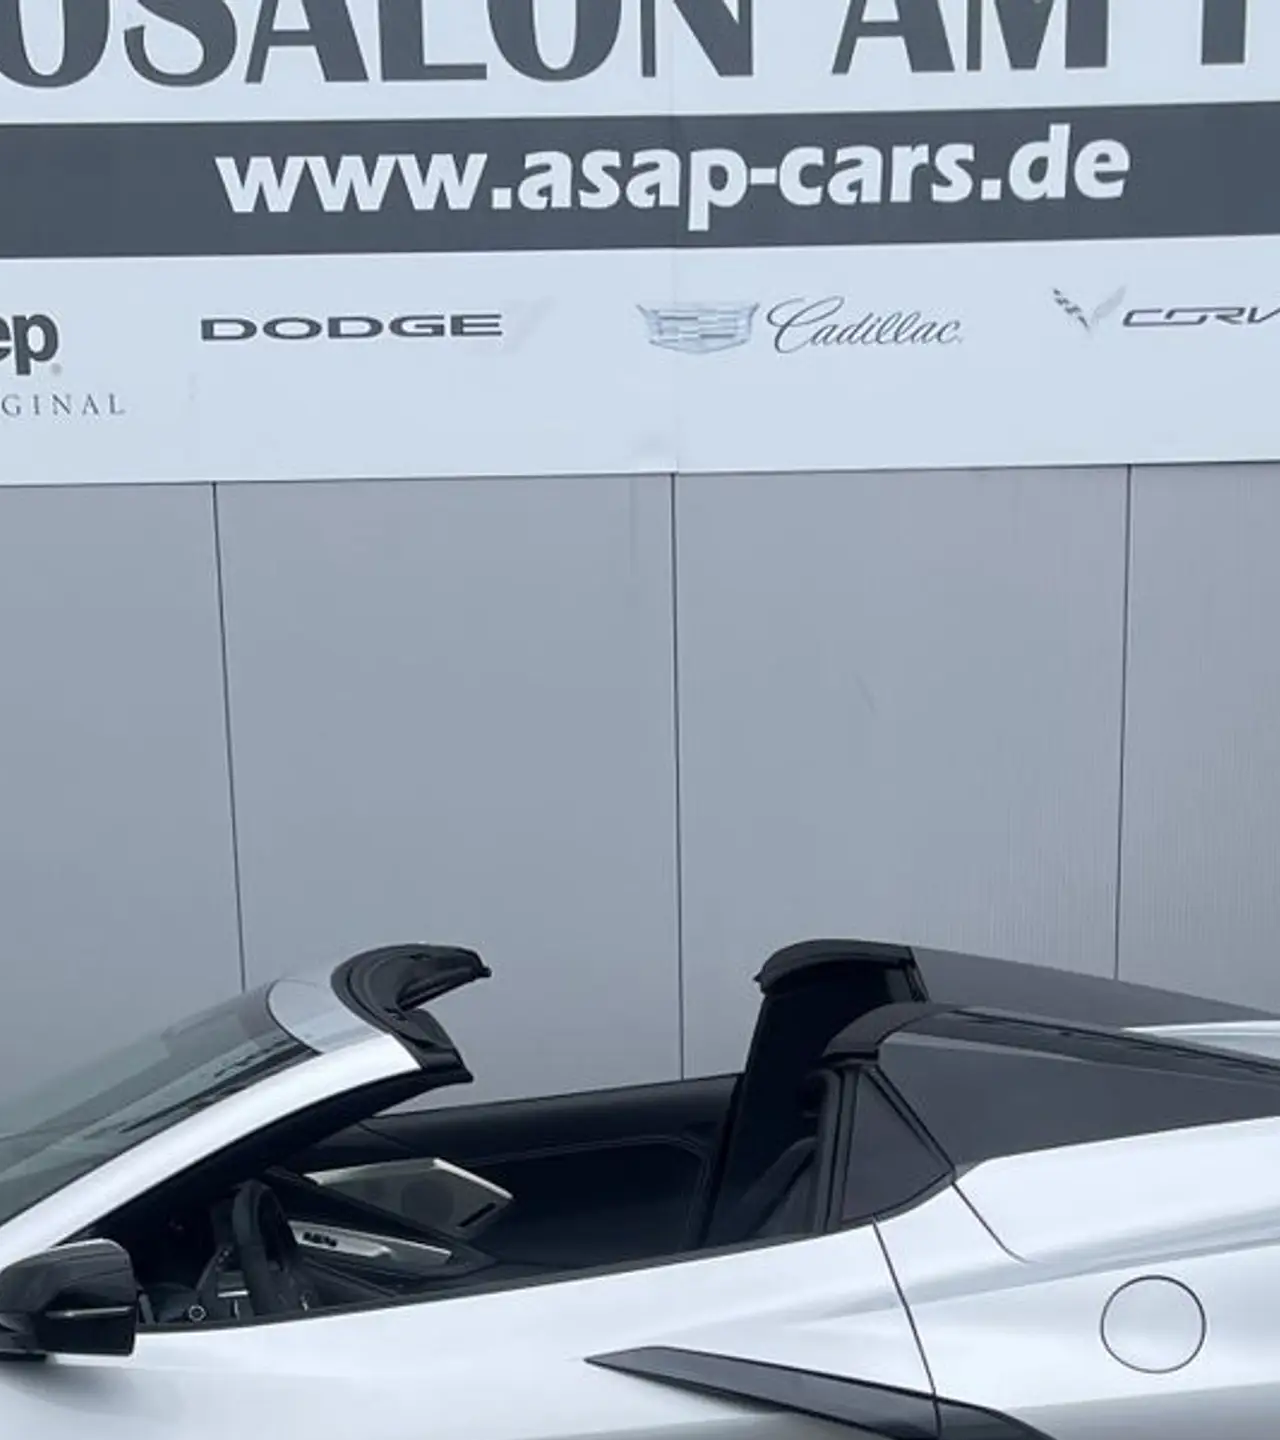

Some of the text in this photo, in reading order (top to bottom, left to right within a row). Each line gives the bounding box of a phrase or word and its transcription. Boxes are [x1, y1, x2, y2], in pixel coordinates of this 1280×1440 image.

[831, 0, 1109, 75] AM
[214, 123, 1131, 232] www.asap-cars.de
[200, 314, 503, 341] DODGE
[765, 295, 961, 354] Cadillac
